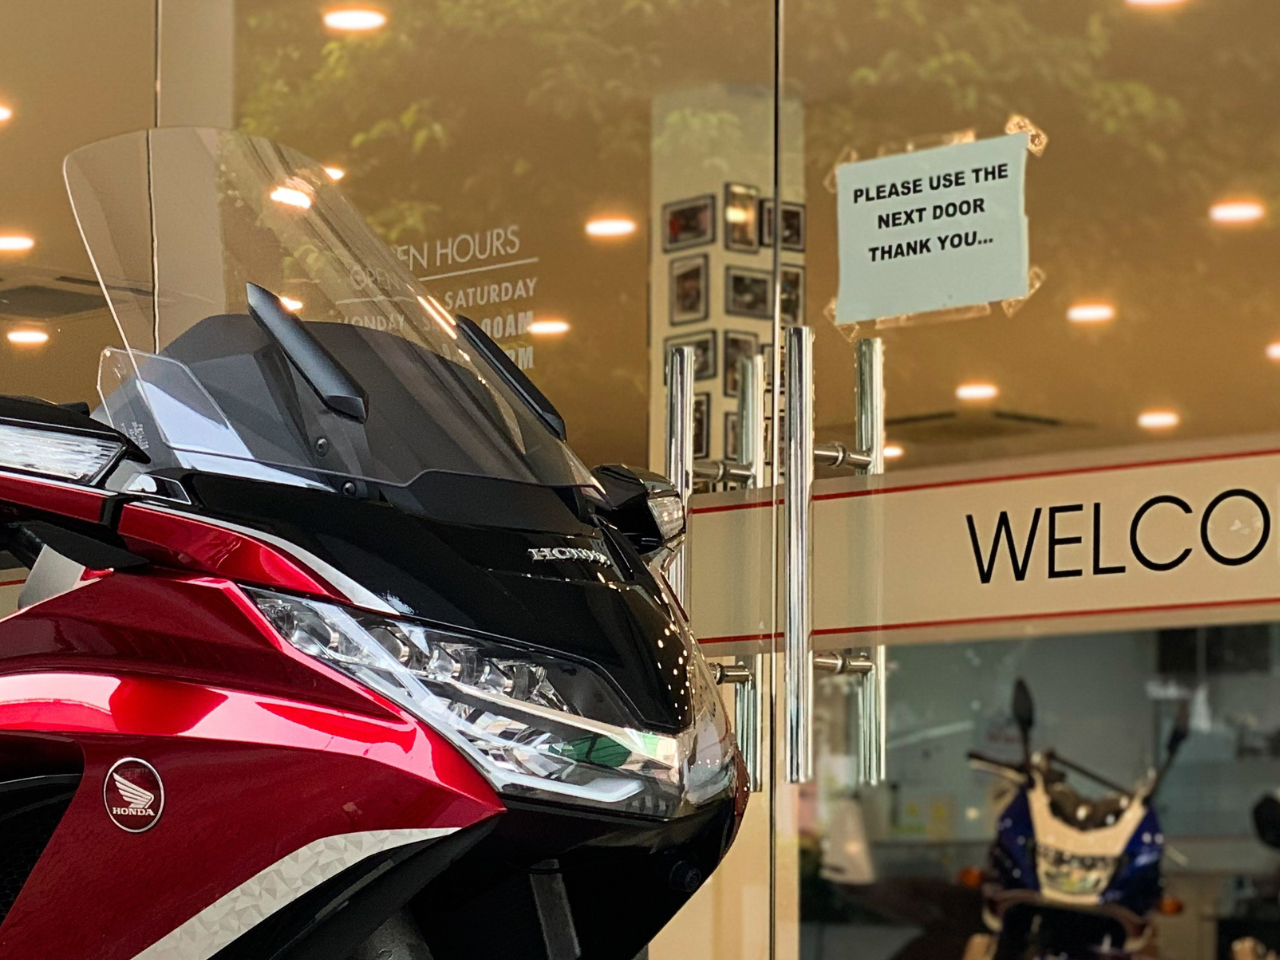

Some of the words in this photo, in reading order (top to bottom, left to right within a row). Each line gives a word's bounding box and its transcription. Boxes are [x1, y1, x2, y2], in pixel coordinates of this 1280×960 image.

[853, 178, 923, 204] PLEASE
[929, 171, 966, 191] USE
[971, 163, 1009, 184] THE
[878, 207, 927, 229] NEXT
[932, 198, 985, 220] DOOR
[436, 225, 520, 267] HOURS
[868, 238, 931, 262] THANK
[937, 231, 994, 251] YOU...
[444, 277, 538, 311] SATURDAY
[966, 488, 1271, 584] WELCO
[112, 806, 156, 816] HONDA
